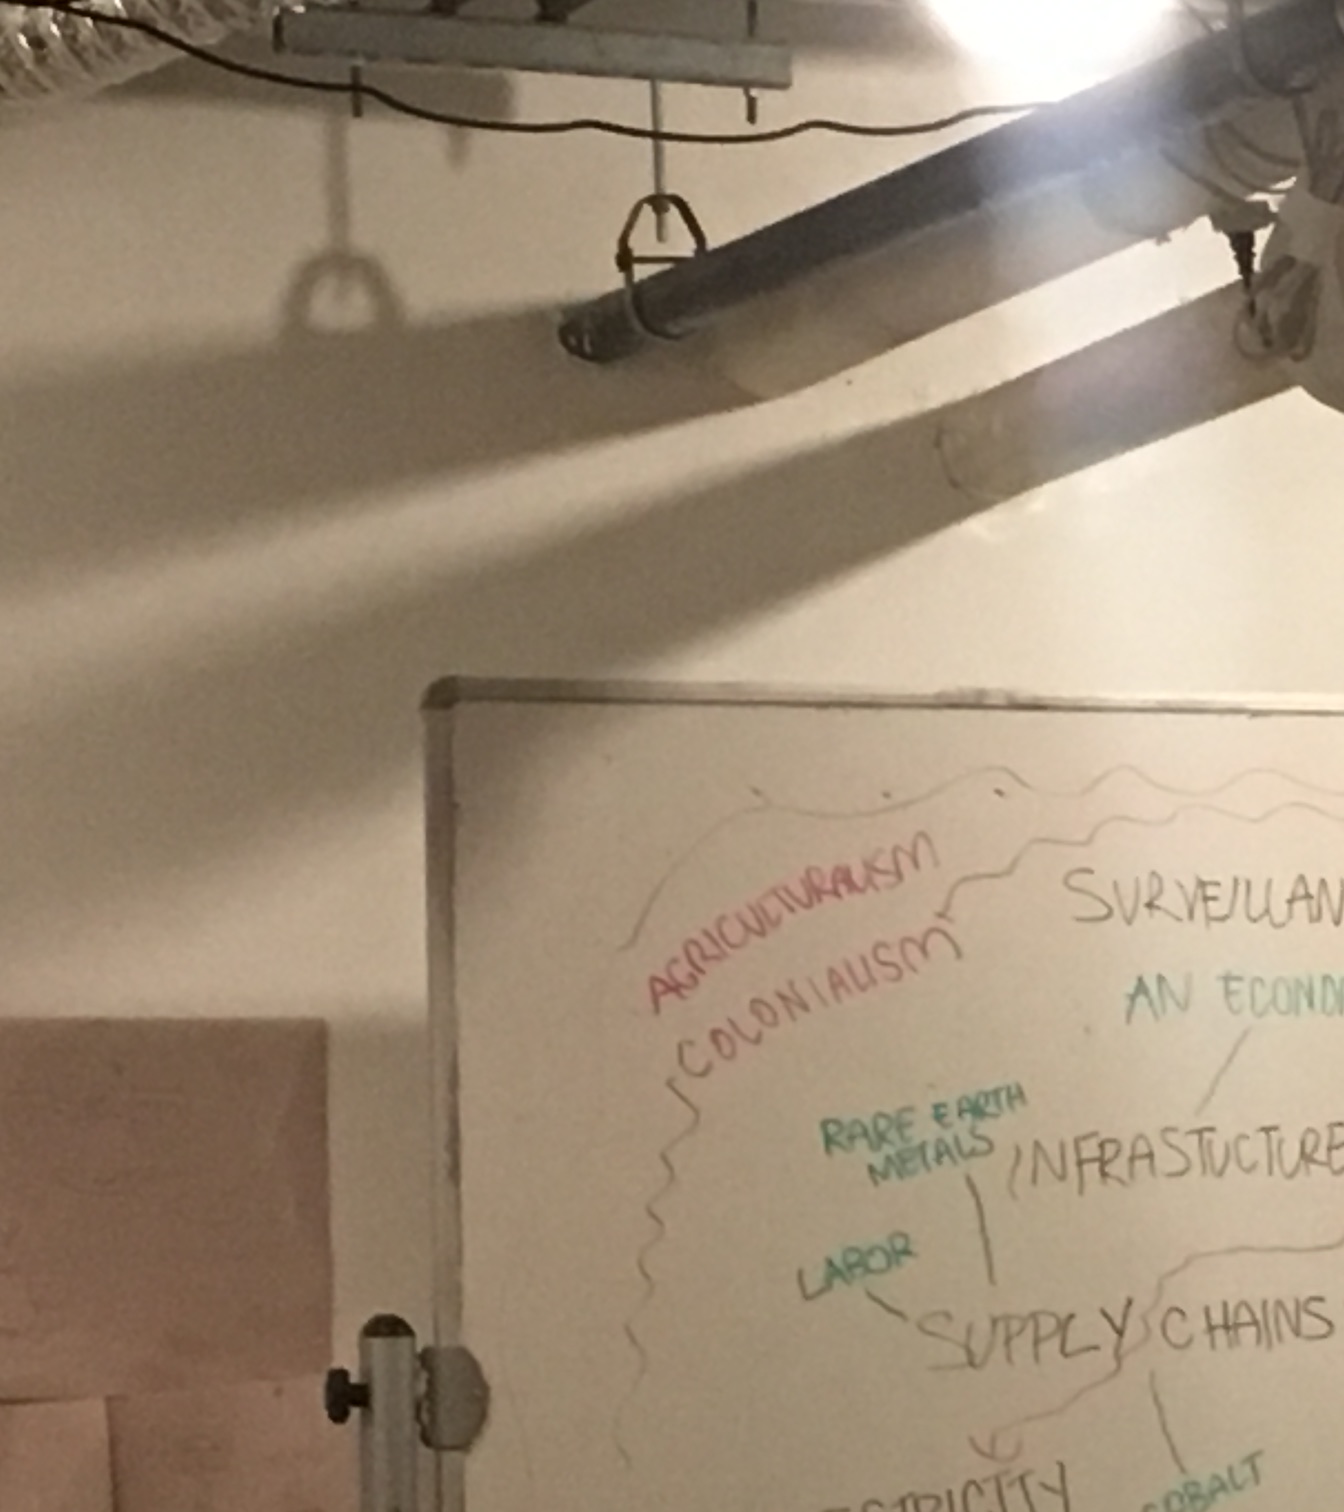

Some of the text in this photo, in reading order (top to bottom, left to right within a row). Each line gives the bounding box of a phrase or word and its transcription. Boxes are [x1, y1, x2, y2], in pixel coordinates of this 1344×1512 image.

[648, 830, 940, 1016] AGRICULTURALISM
[676, 926, 963, 1079] COLONIALISM
[1124, 971, 1195, 1026] AN
[820, 1082, 1028, 1156] RARE EARTH
[866, 1125, 995, 1187] METALS
[797, 1230, 917, 1303] LABOR
[916, 1296, 1335, 1373] SUPPLY CHAINS
